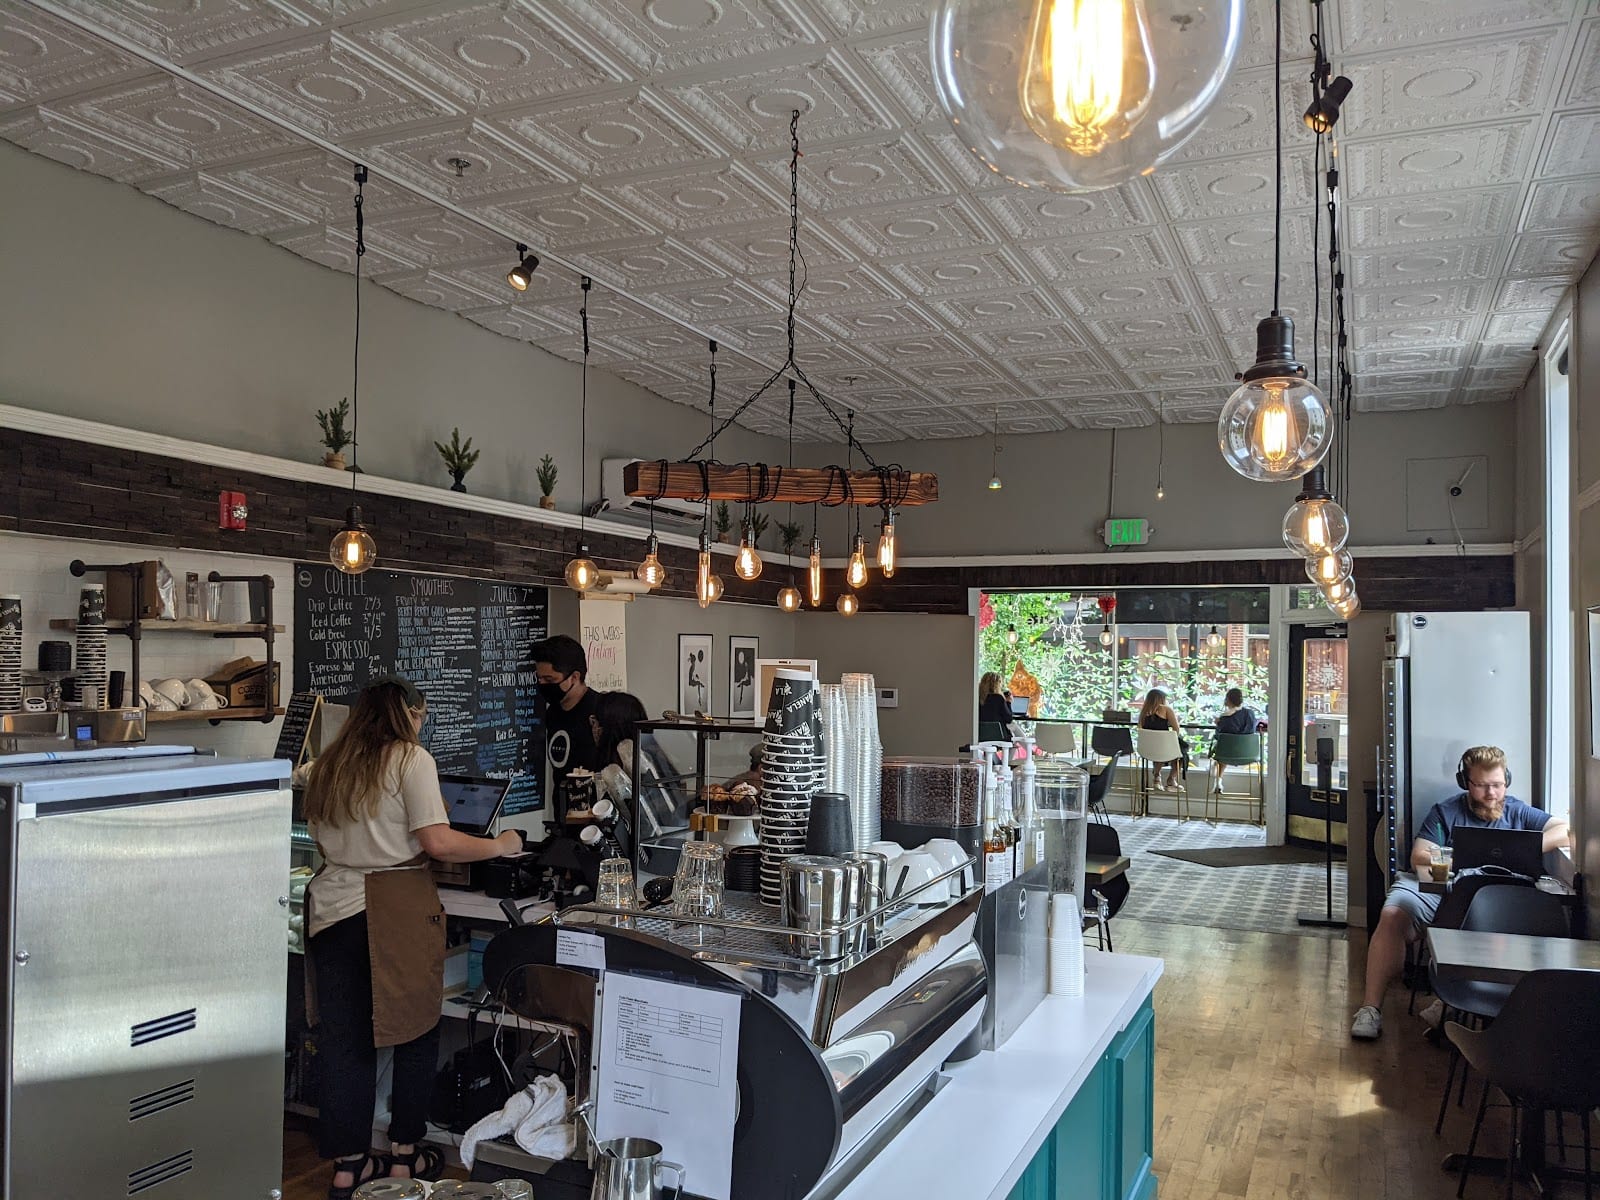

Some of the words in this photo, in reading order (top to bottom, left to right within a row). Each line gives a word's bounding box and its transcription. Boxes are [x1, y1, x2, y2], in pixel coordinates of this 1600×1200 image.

[1111, 520, 1143, 543] EXIT
[325, 569, 367, 596] COFFEE
[410, 577, 454, 596] SMOOTHIES
[489, 585, 517, 603] JUICES
[308, 598, 326, 613] Drip
[329, 597, 353, 612] Coffee
[311, 613, 328, 627] Iced
[330, 613, 352, 628] Coffee
[309, 629, 326, 641] Cold
[328, 628, 345, 640] Brew
[364, 624, 382, 640] 4/5
[583, 626, 600, 641] THIS
[325, 640, 370, 660] ESPRESSO
[308, 661, 341, 674] Espresso
[342, 660, 355, 672] Shot
[310, 672, 353, 686] Americano
[492, 673, 516, 687] BLENDED
[518, 671, 538, 686] DRINKS
